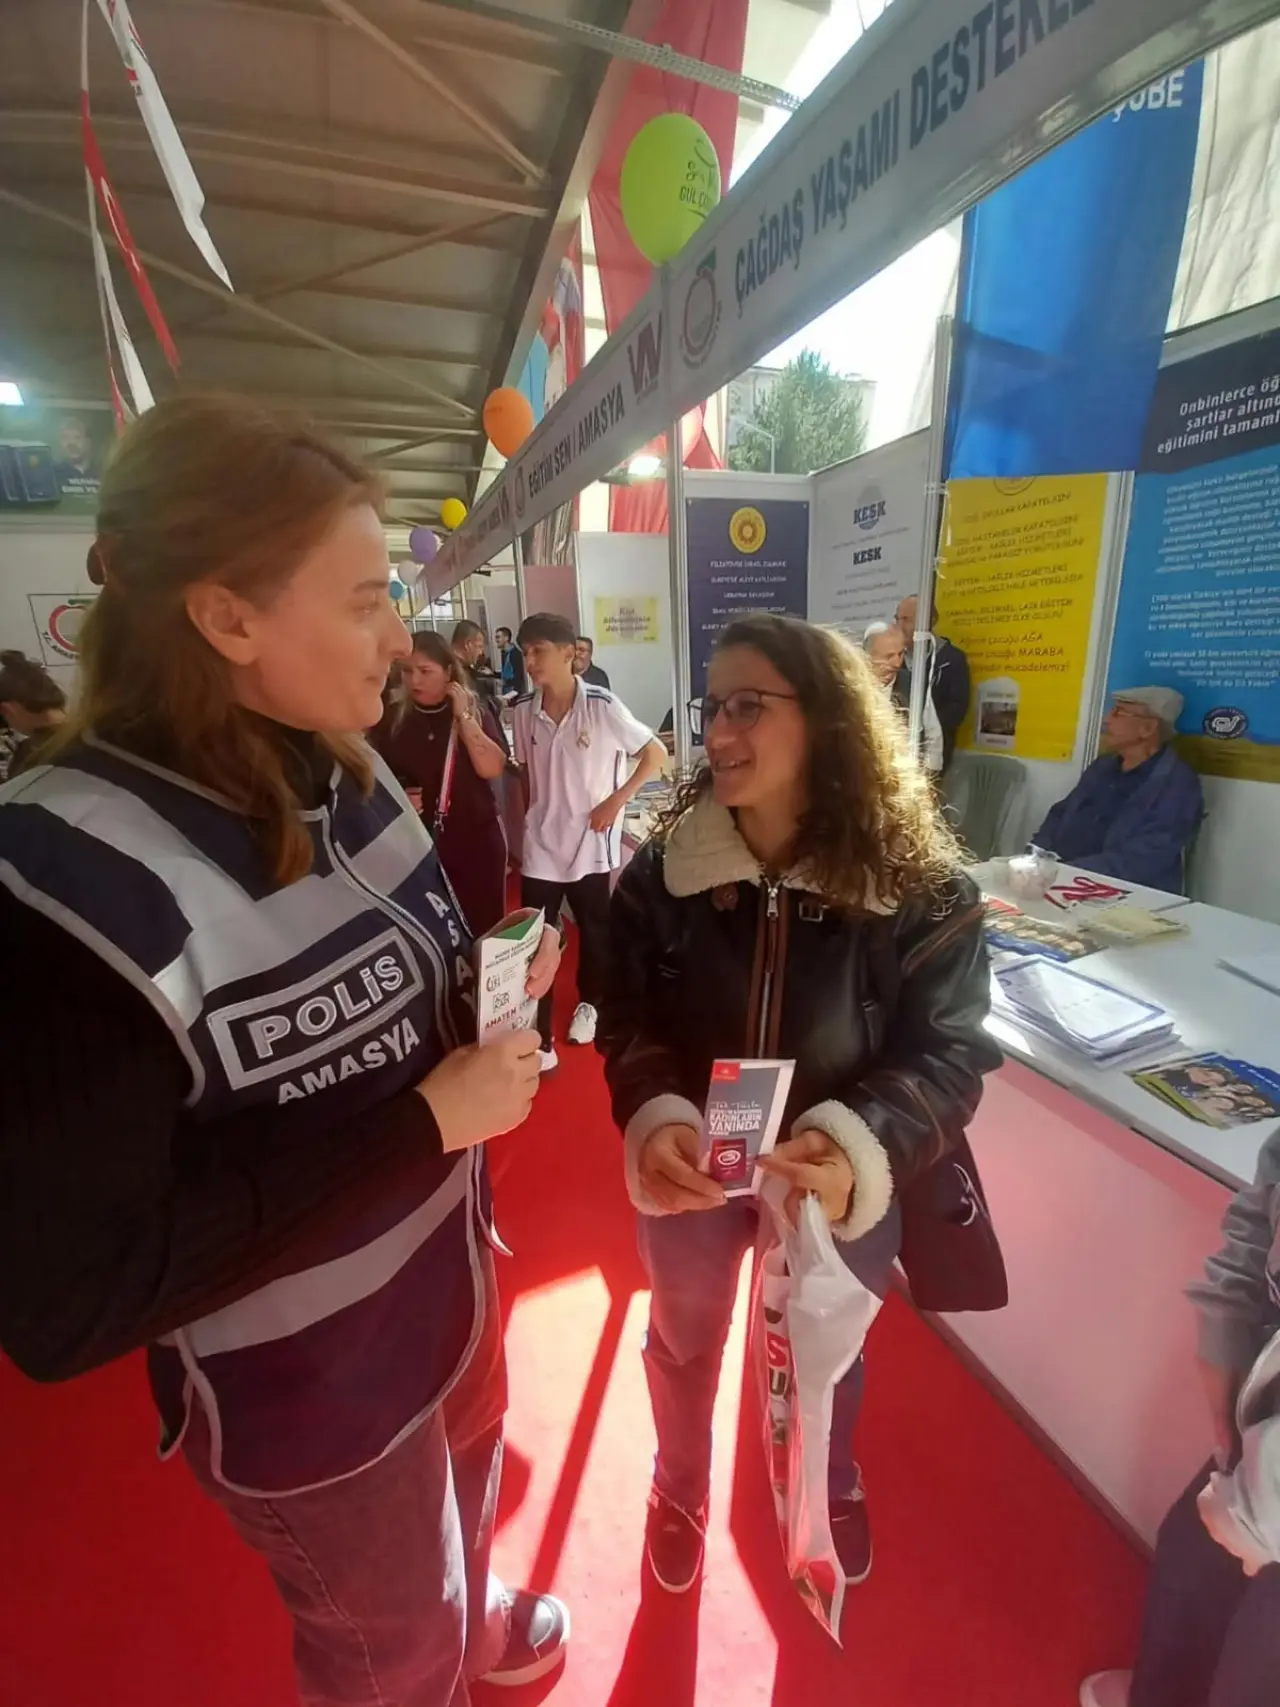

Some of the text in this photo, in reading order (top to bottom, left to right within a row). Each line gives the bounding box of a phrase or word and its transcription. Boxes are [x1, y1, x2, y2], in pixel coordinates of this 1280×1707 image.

[735, 0, 1095, 320] ÇAĞDAŞ YAŞAMI DESTEK
[1179, 384, 1255, 416] Onbinlerce
[554, 433, 572, 477] SEN
[577, 381, 626, 457] AMASYA
[1158, 425, 1219, 454] eğitimini
[853, 500, 886, 525] KESK
[853, 545, 882, 565] KESK
[1018, 646, 1064, 657] MARABA
[277, 1017, 421, 1106] AMASYA
[710, 1118, 760, 1133] YANINDA
